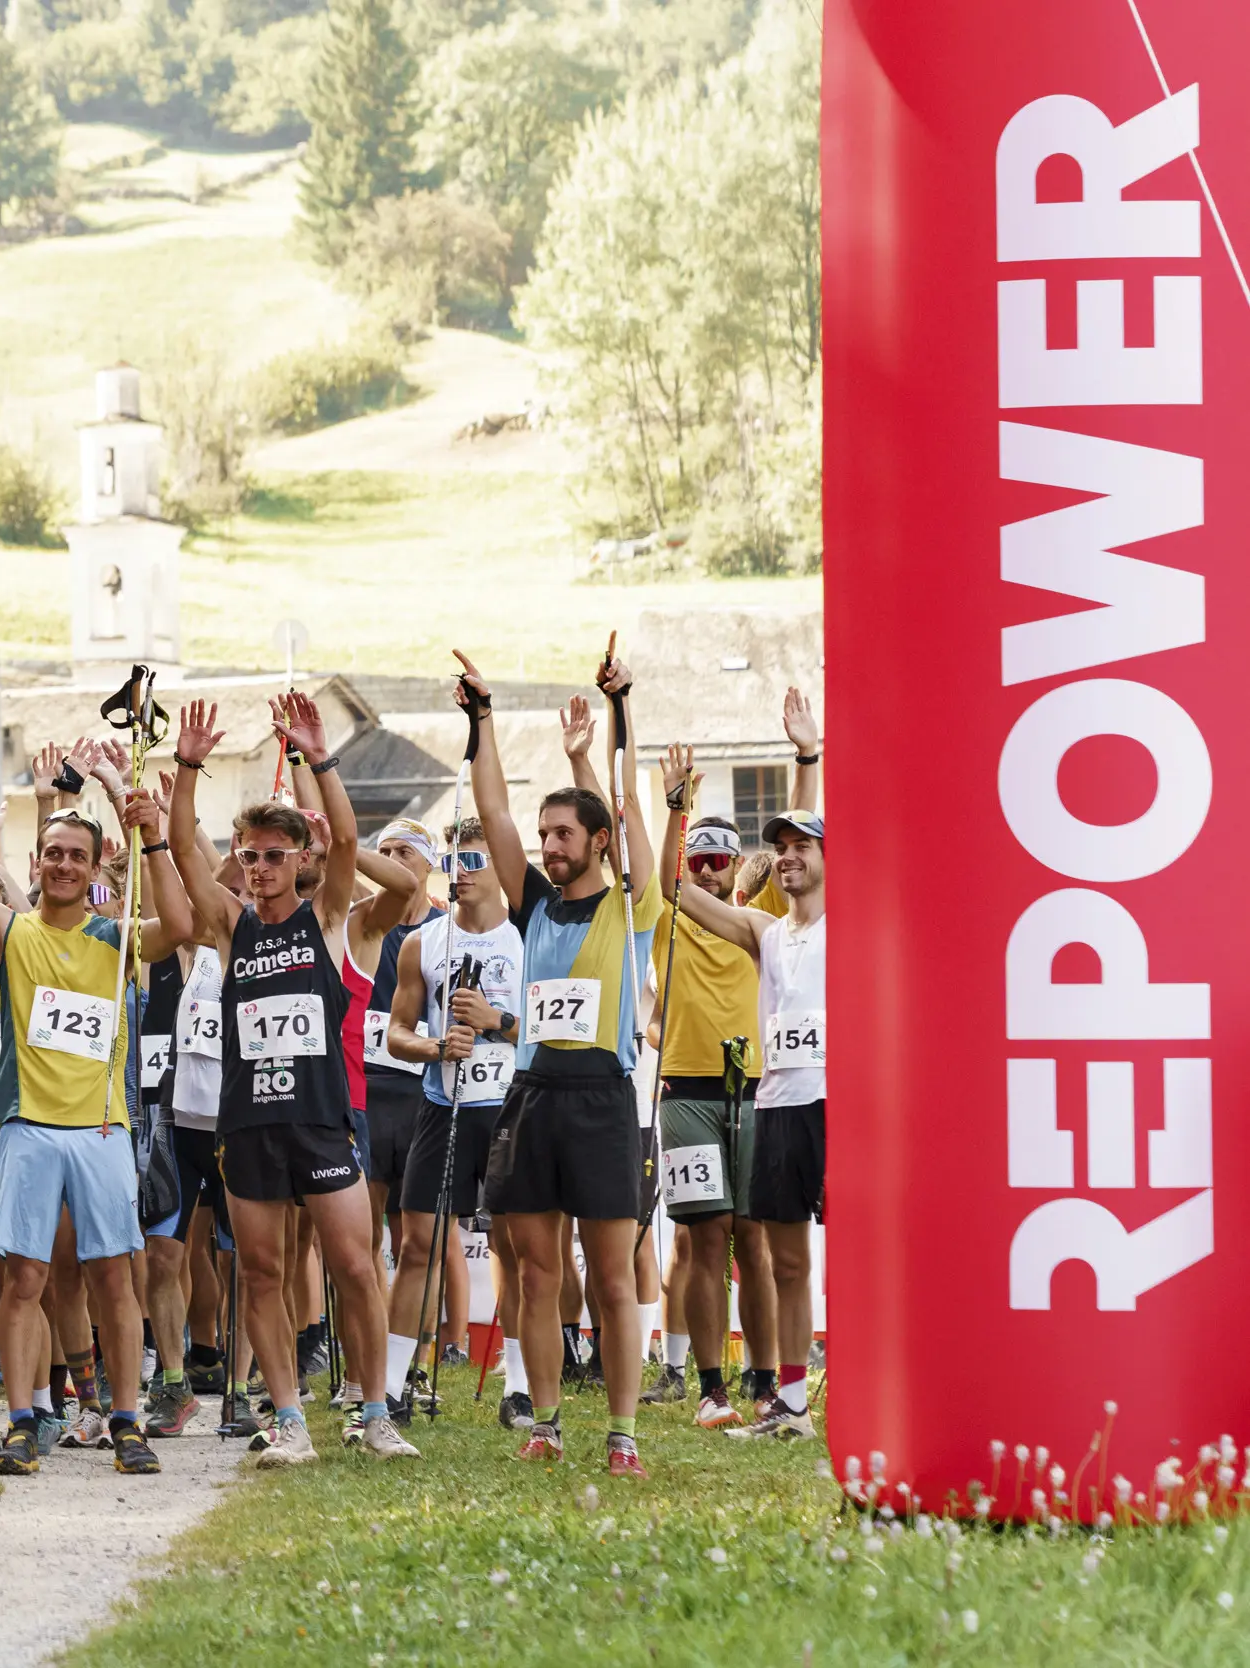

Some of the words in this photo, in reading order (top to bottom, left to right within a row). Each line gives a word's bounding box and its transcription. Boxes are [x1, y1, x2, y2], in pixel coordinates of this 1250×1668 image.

[996, 82, 1214, 1312] REPOWER
[255, 937, 286, 953] g.s.a.
[234, 945, 315, 978] Cometa
[535, 999, 585, 1022] 127
[47, 1008, 101, 1038] 123
[192, 1017, 222, 1040] 13
[253, 1014, 310, 1039] 170
[773, 1028, 819, 1050] 154
[253, 1070, 295, 1095] RO
[253, 1093, 295, 1104] livigno.com
[312, 1166, 351, 1180] LIVIGNO
[667, 1163, 710, 1187] 113
